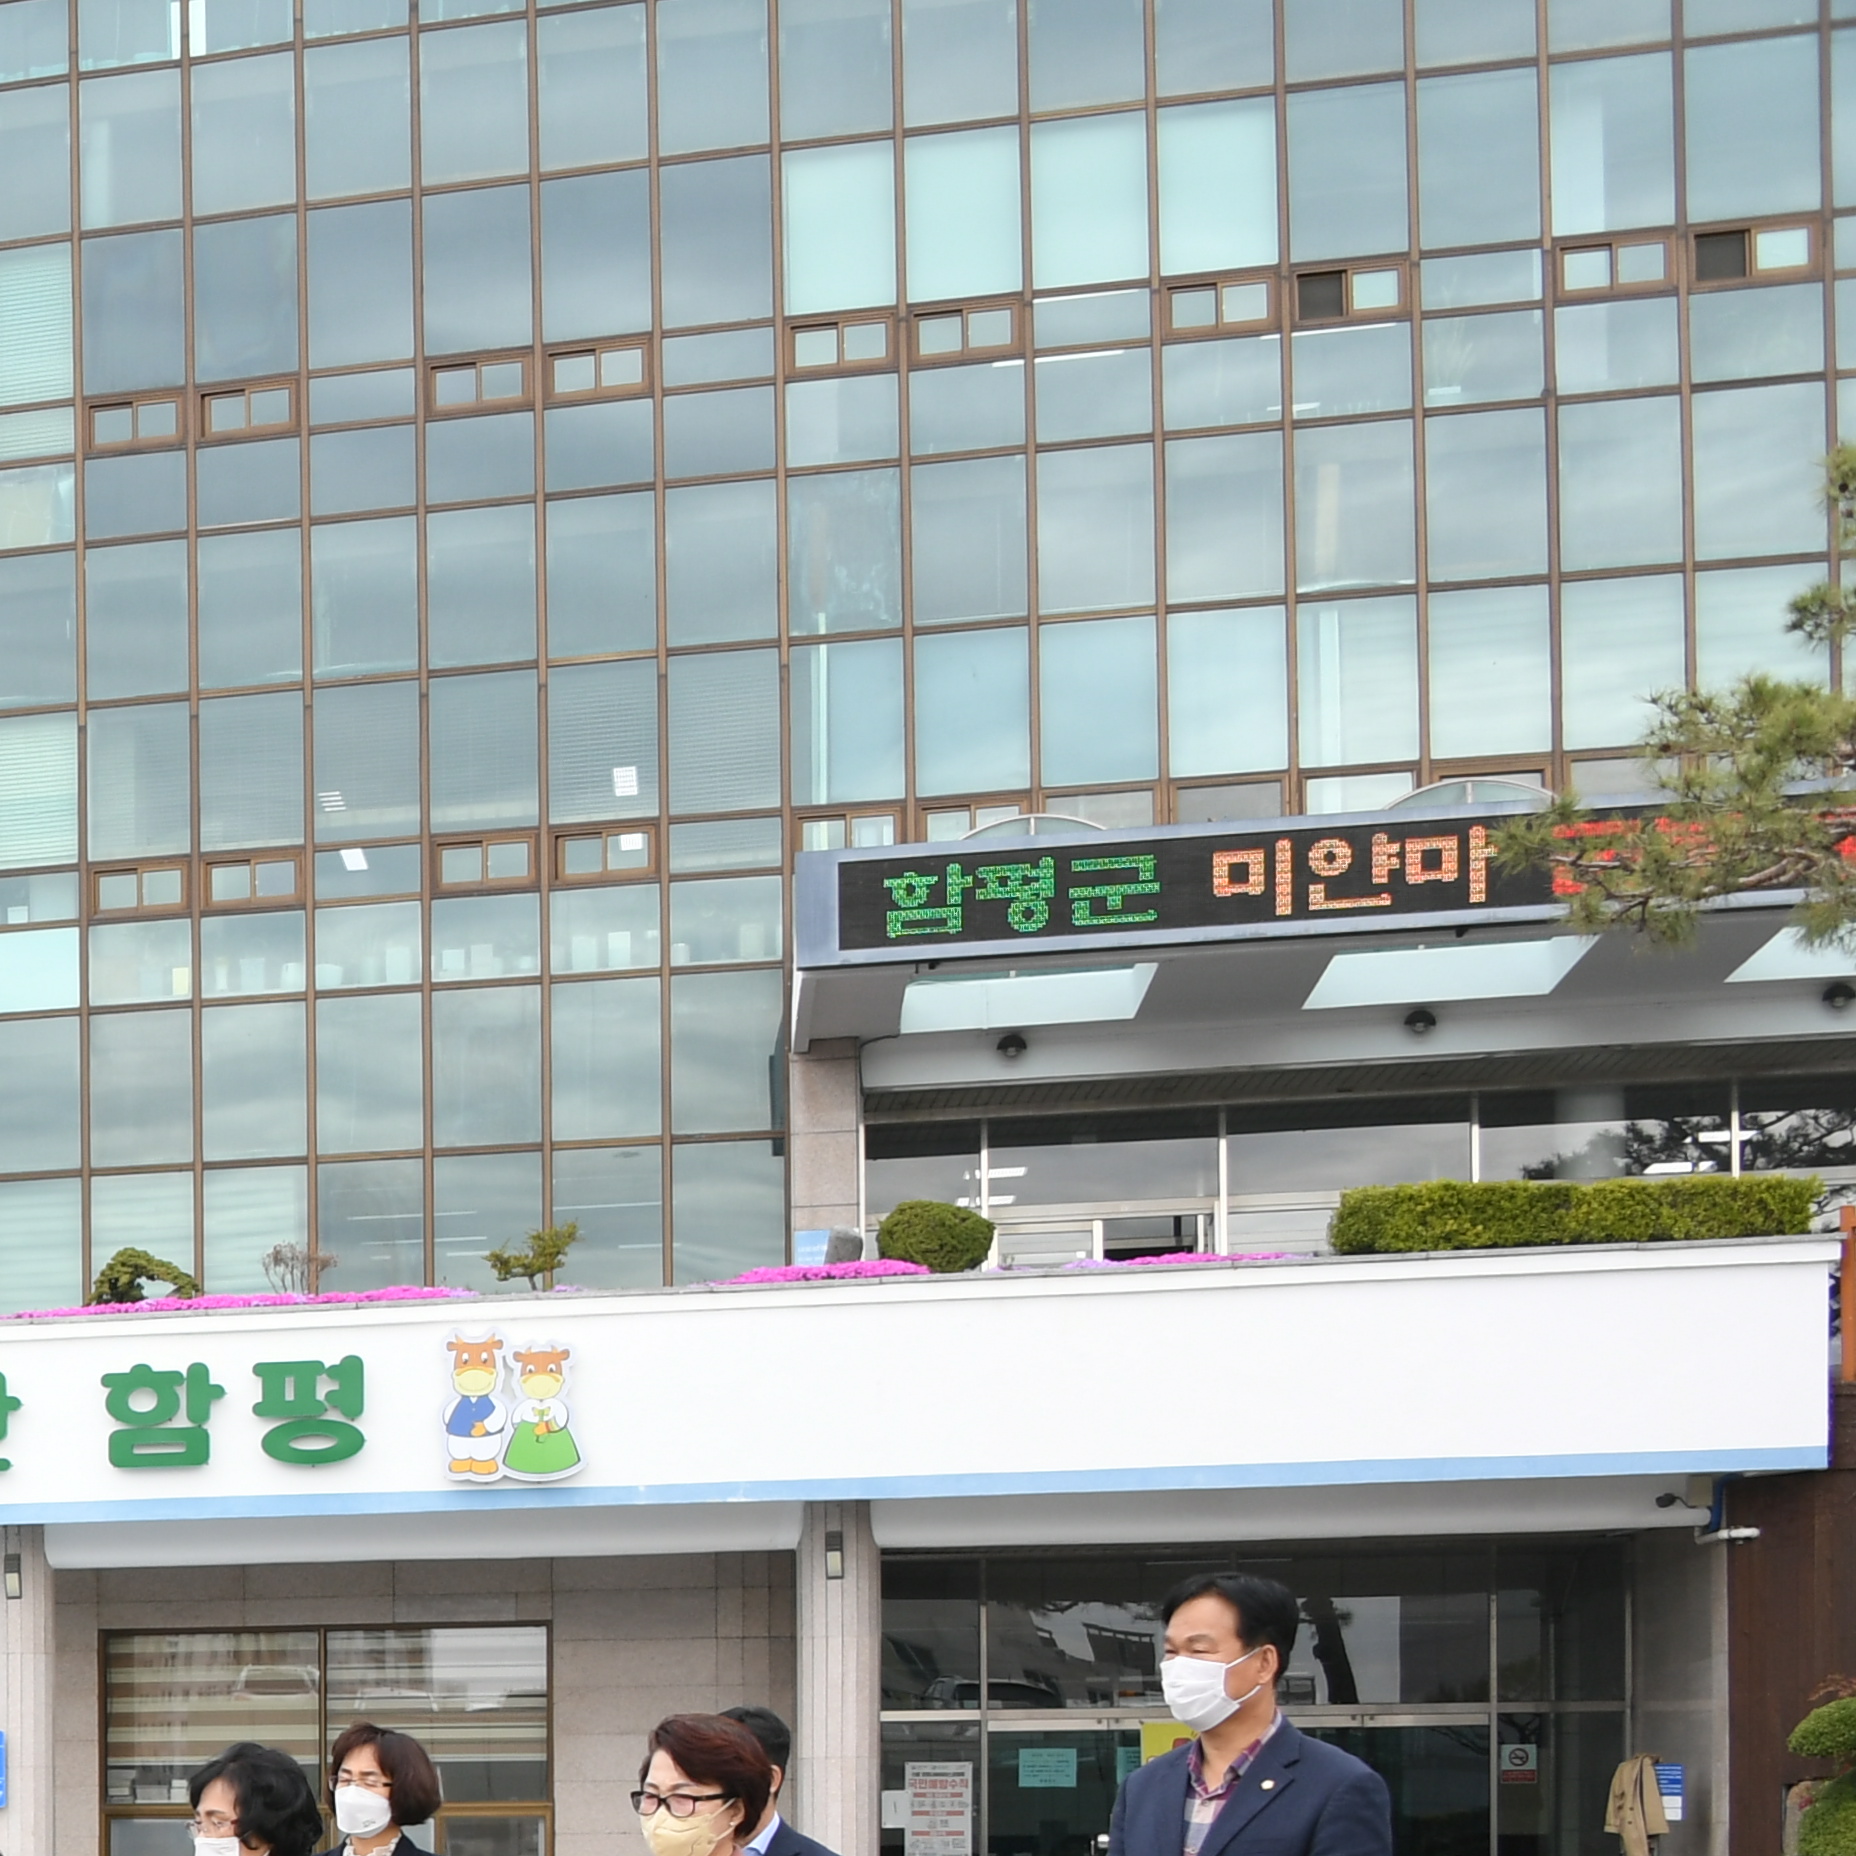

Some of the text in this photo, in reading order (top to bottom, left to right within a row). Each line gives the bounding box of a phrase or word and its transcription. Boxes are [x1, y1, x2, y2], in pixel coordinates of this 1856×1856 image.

[883, 854, 1162, 938] 함평군
[1212, 824, 1496, 916] 미얀마
[104, 1355, 366, 1469] 함평
